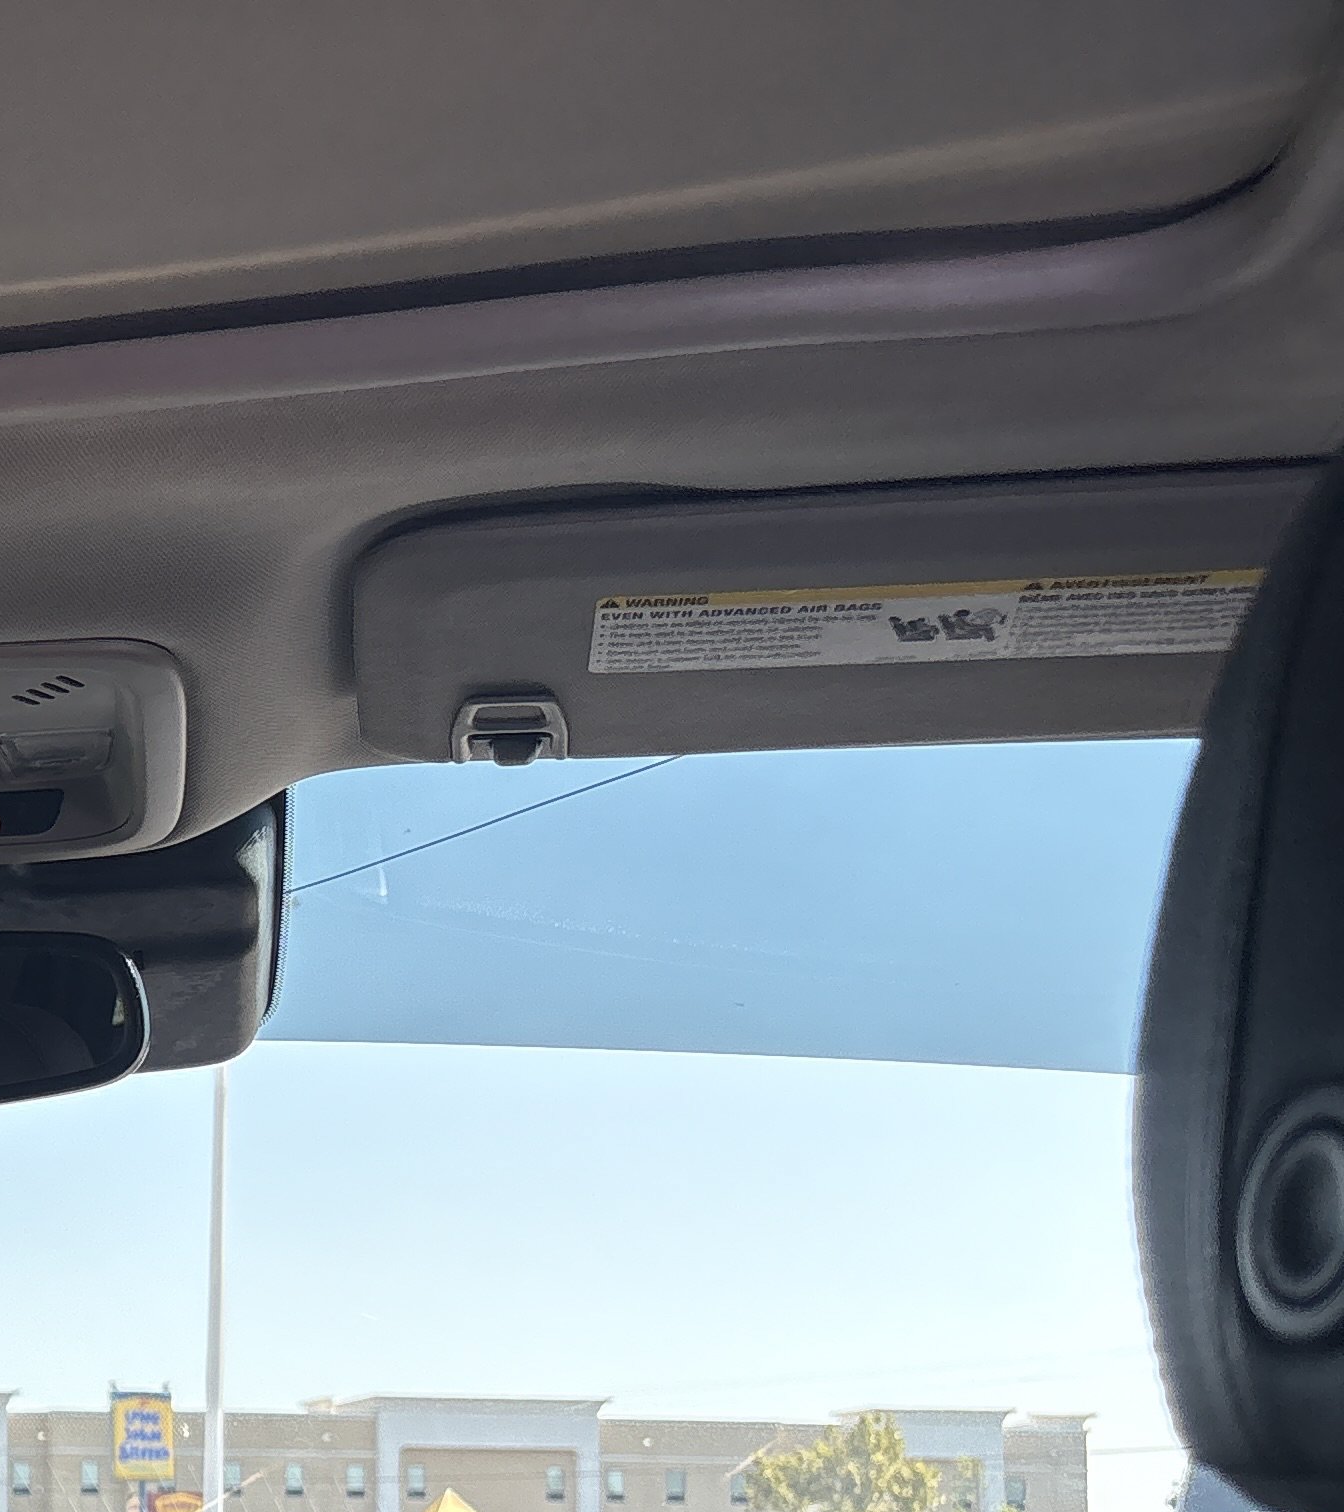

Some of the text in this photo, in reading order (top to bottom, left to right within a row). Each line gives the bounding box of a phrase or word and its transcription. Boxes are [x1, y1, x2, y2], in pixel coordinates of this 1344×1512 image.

[626, 596, 708, 608] WARNING
[601, 602, 883, 621] EVEN WITH ADVANCED AIR BAGS
